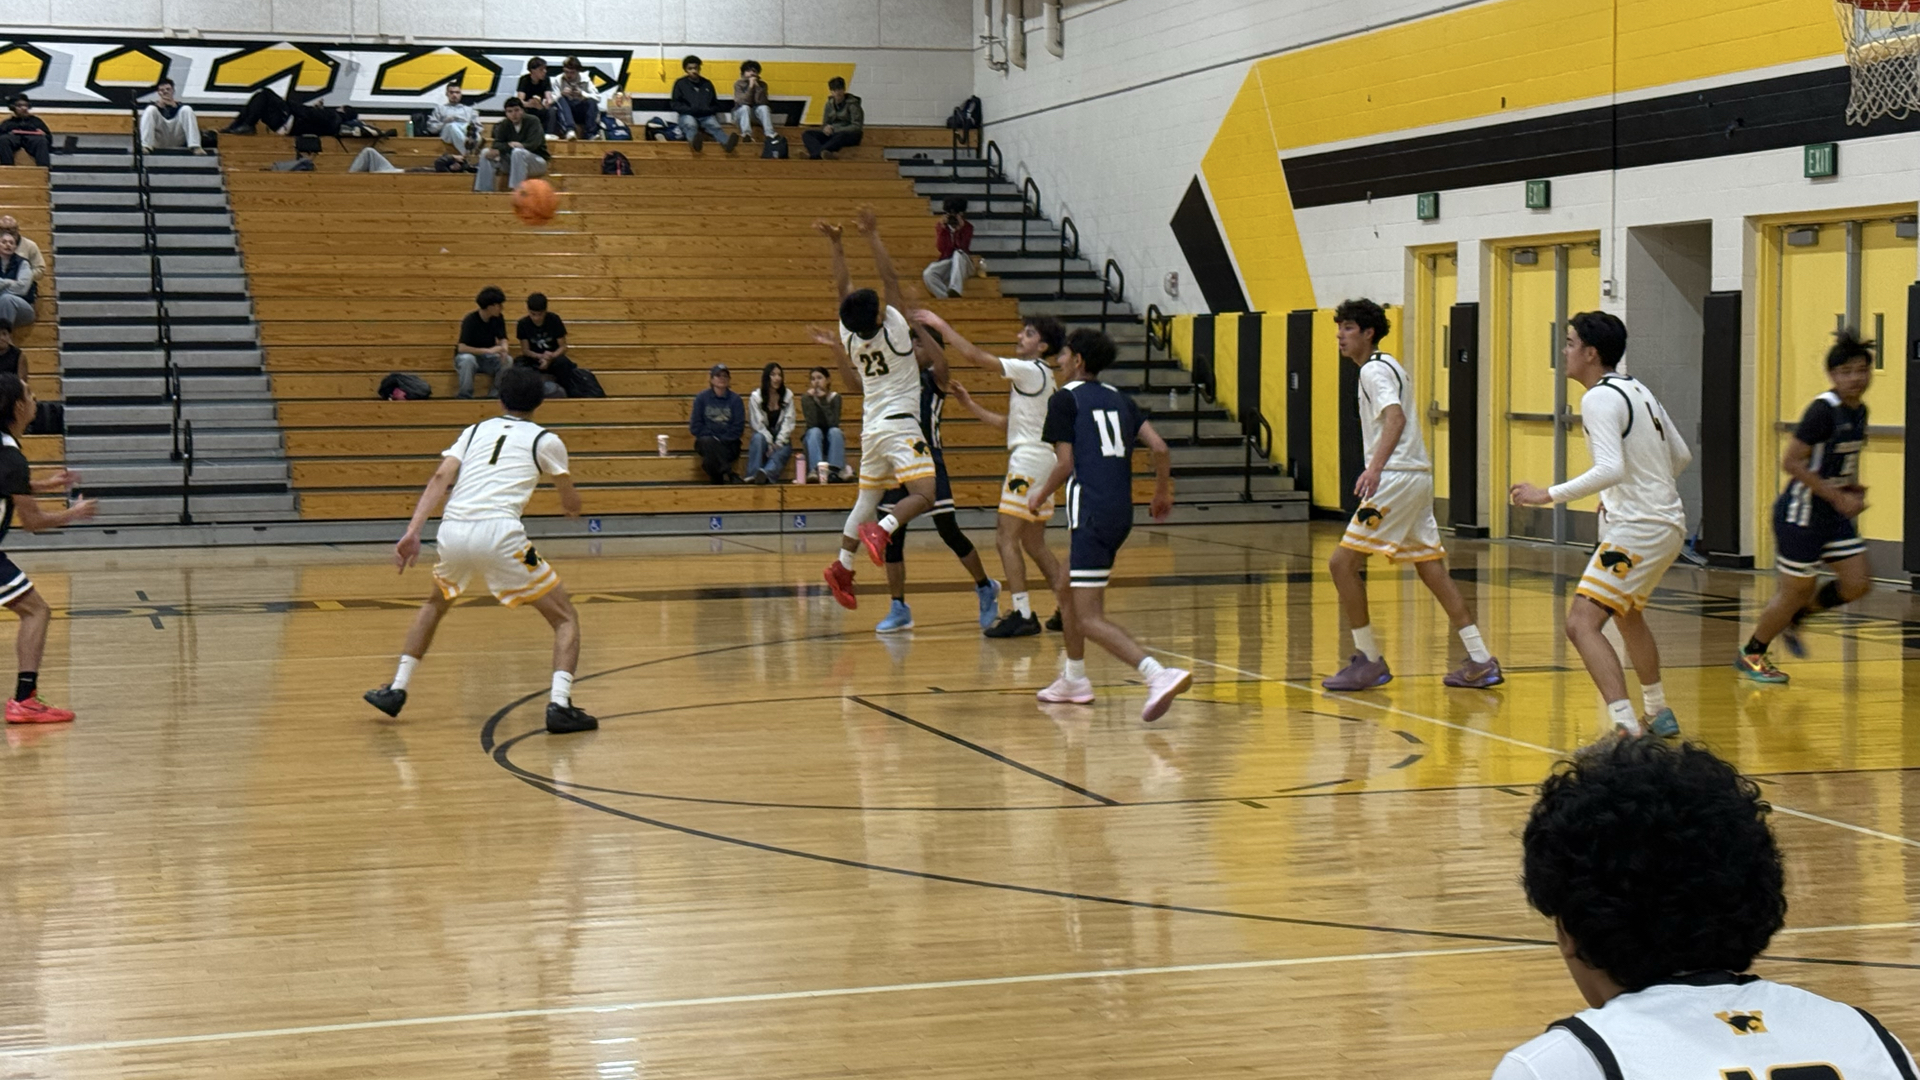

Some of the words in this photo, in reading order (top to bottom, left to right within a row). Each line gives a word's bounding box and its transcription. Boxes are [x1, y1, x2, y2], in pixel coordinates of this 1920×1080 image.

[1808, 147, 1831, 174] EXIT
[859, 350, 889, 377] 23
[1092, 409, 1126, 457] 11
[1645, 401, 1666, 441] 4
[488, 434, 507, 465] 1
